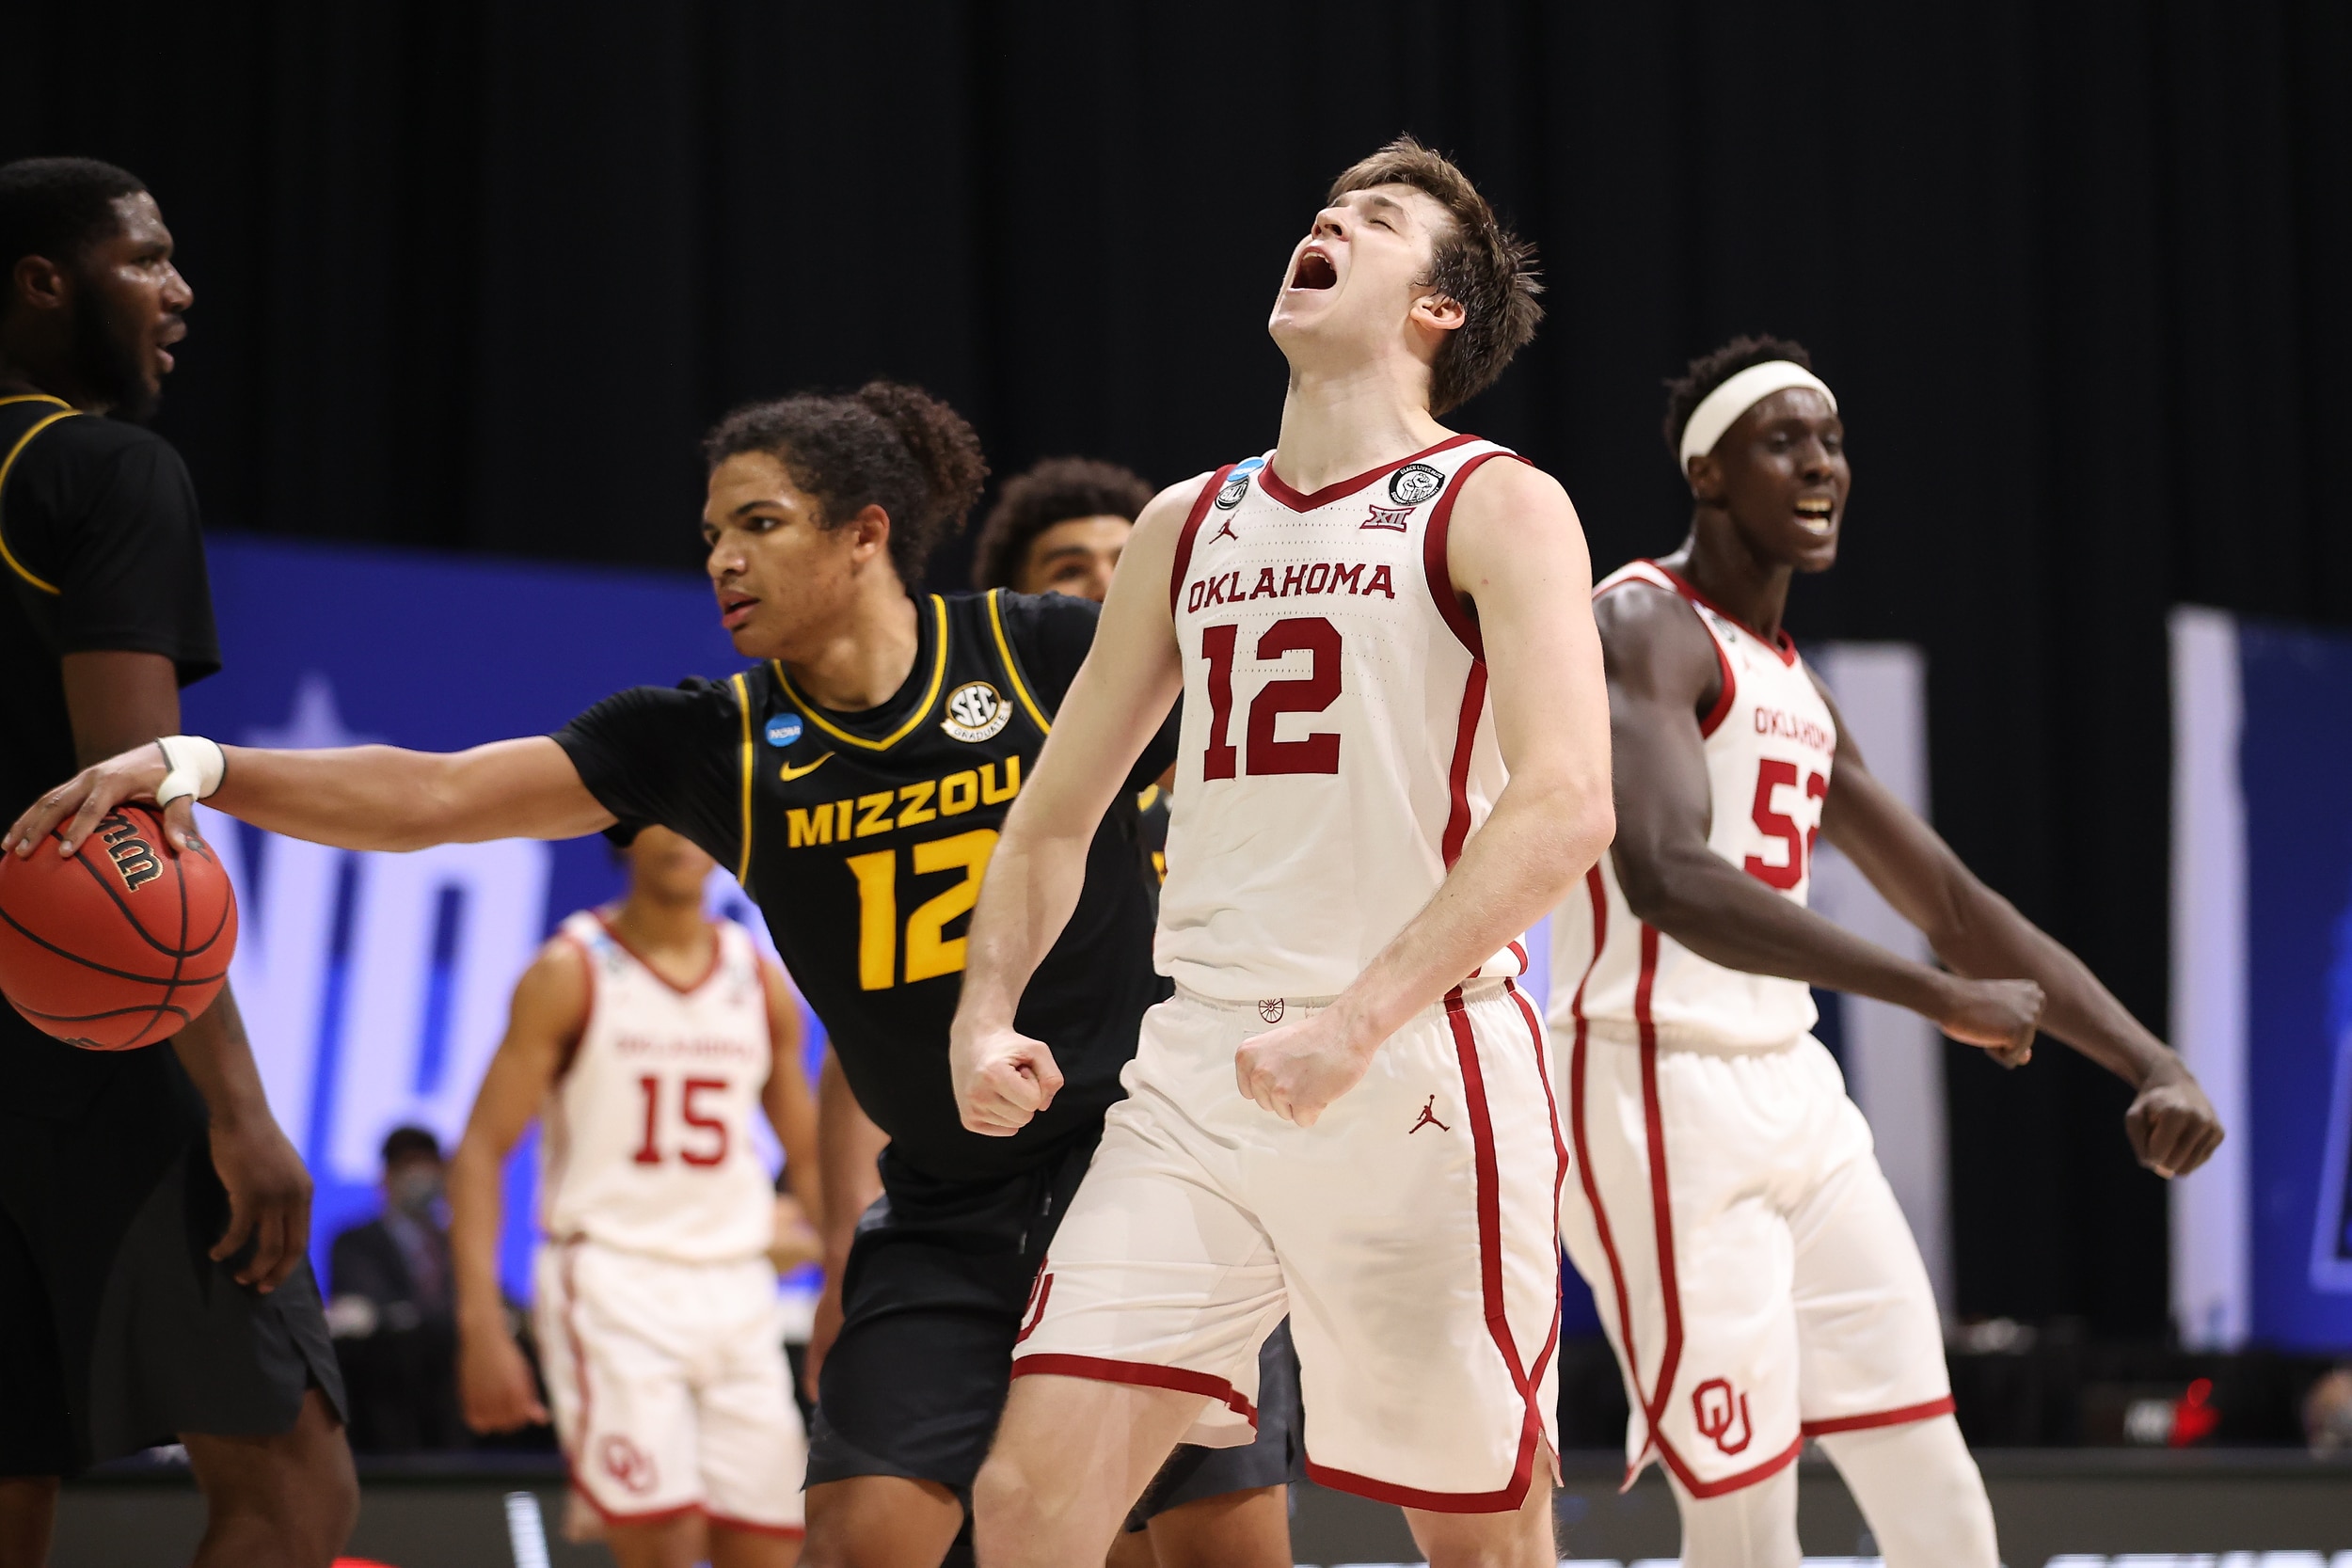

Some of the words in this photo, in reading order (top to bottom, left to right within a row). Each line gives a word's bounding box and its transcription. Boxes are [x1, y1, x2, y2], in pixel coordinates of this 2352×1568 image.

[1187, 562, 1395, 614] OKLAHOMA
[950, 685, 998, 727] SEC
[954, 714, 1008, 740] GRADUATE
[1202, 616, 1343, 783] 12
[785, 755, 1022, 849] MIZZOU
[845, 828, 1002, 991] 12
[633, 1075, 729, 1166] 15
[1692, 1378, 1752, 1456] OU
